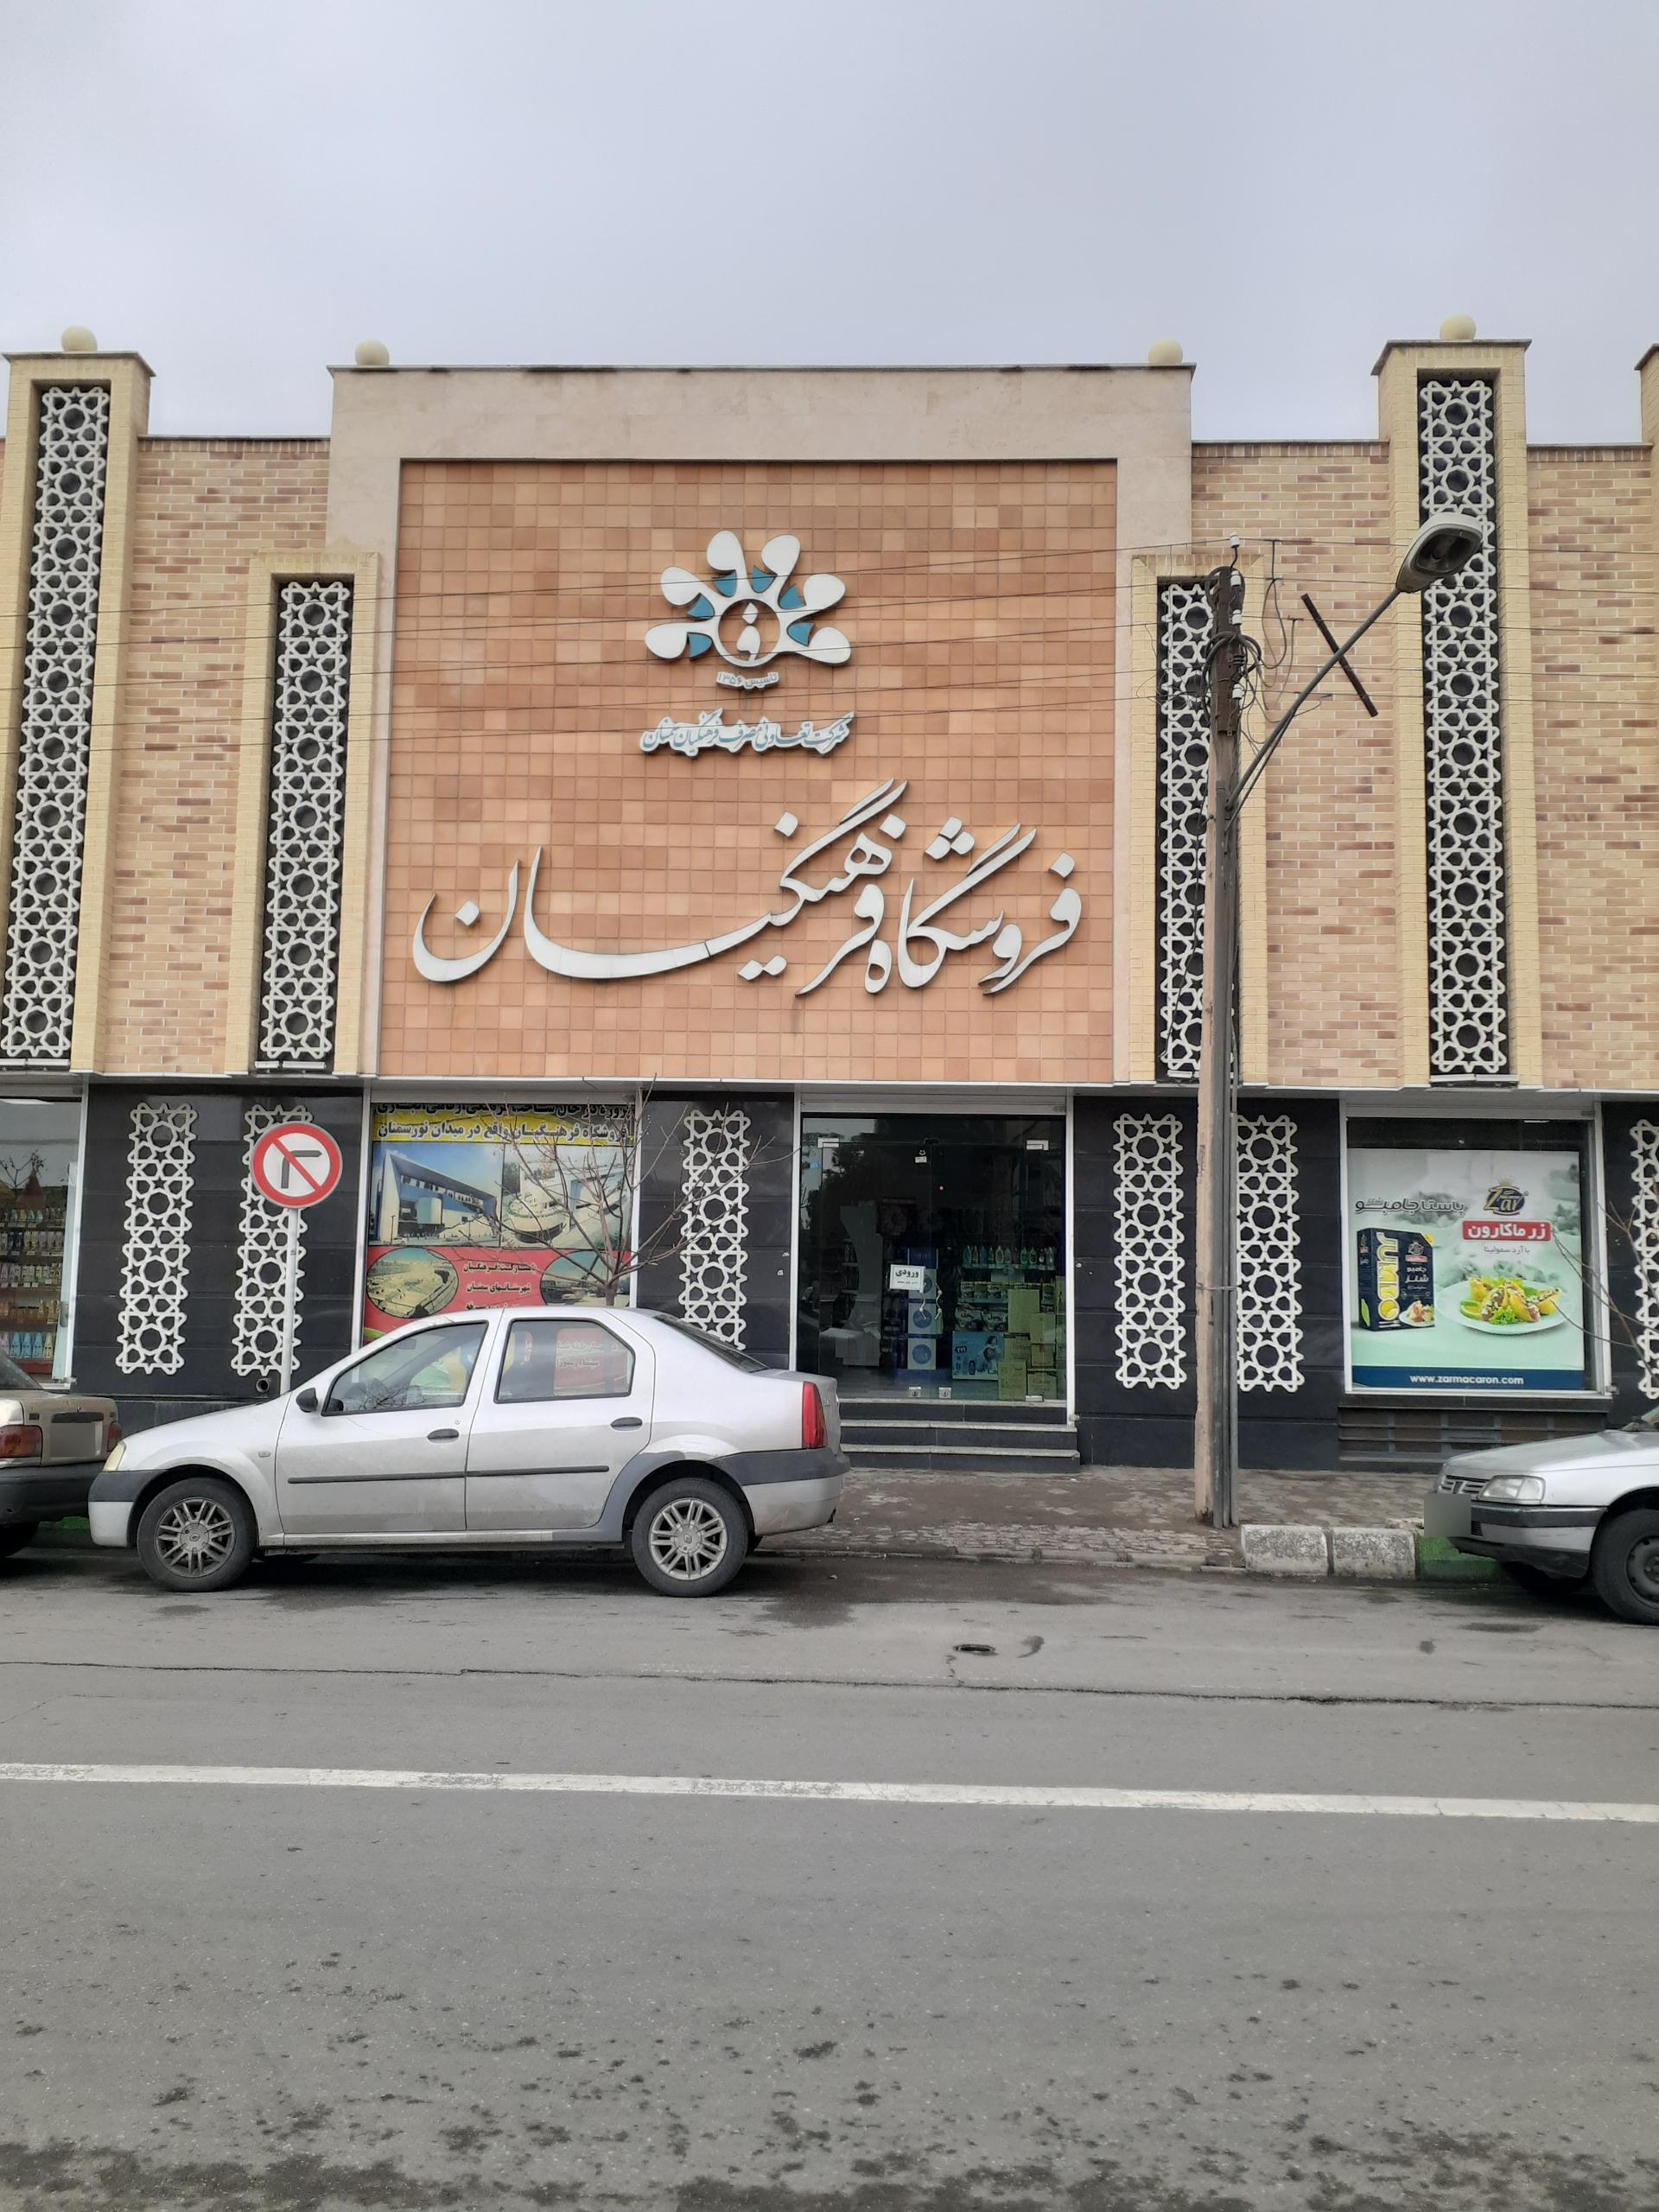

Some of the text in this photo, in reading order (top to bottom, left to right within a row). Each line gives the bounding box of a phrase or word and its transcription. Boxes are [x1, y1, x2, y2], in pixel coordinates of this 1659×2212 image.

[674, 709, 722, 754] فرهنگیان
[719, 721, 763, 751] مصرف
[754, 719, 810, 749] تعاونی
[804, 712, 854, 752] شرکت
[412, 777, 1082, 996] فروشگاه فرهنگیان
[378, 1122, 411, 1137] سمنان
[431, 1122, 464, 1138] میدان
[467, 1125, 480, 1138] در
[1422, 1198, 1465, 1216] پاستا
[1483, 1187, 1523, 1211] Zar
[1468, 1223, 1547, 1240] زر ماکارون
[895, 1269, 919, 1278] ورودی
[1409, 1375, 1524, 1385] www.zarmacaron.com
